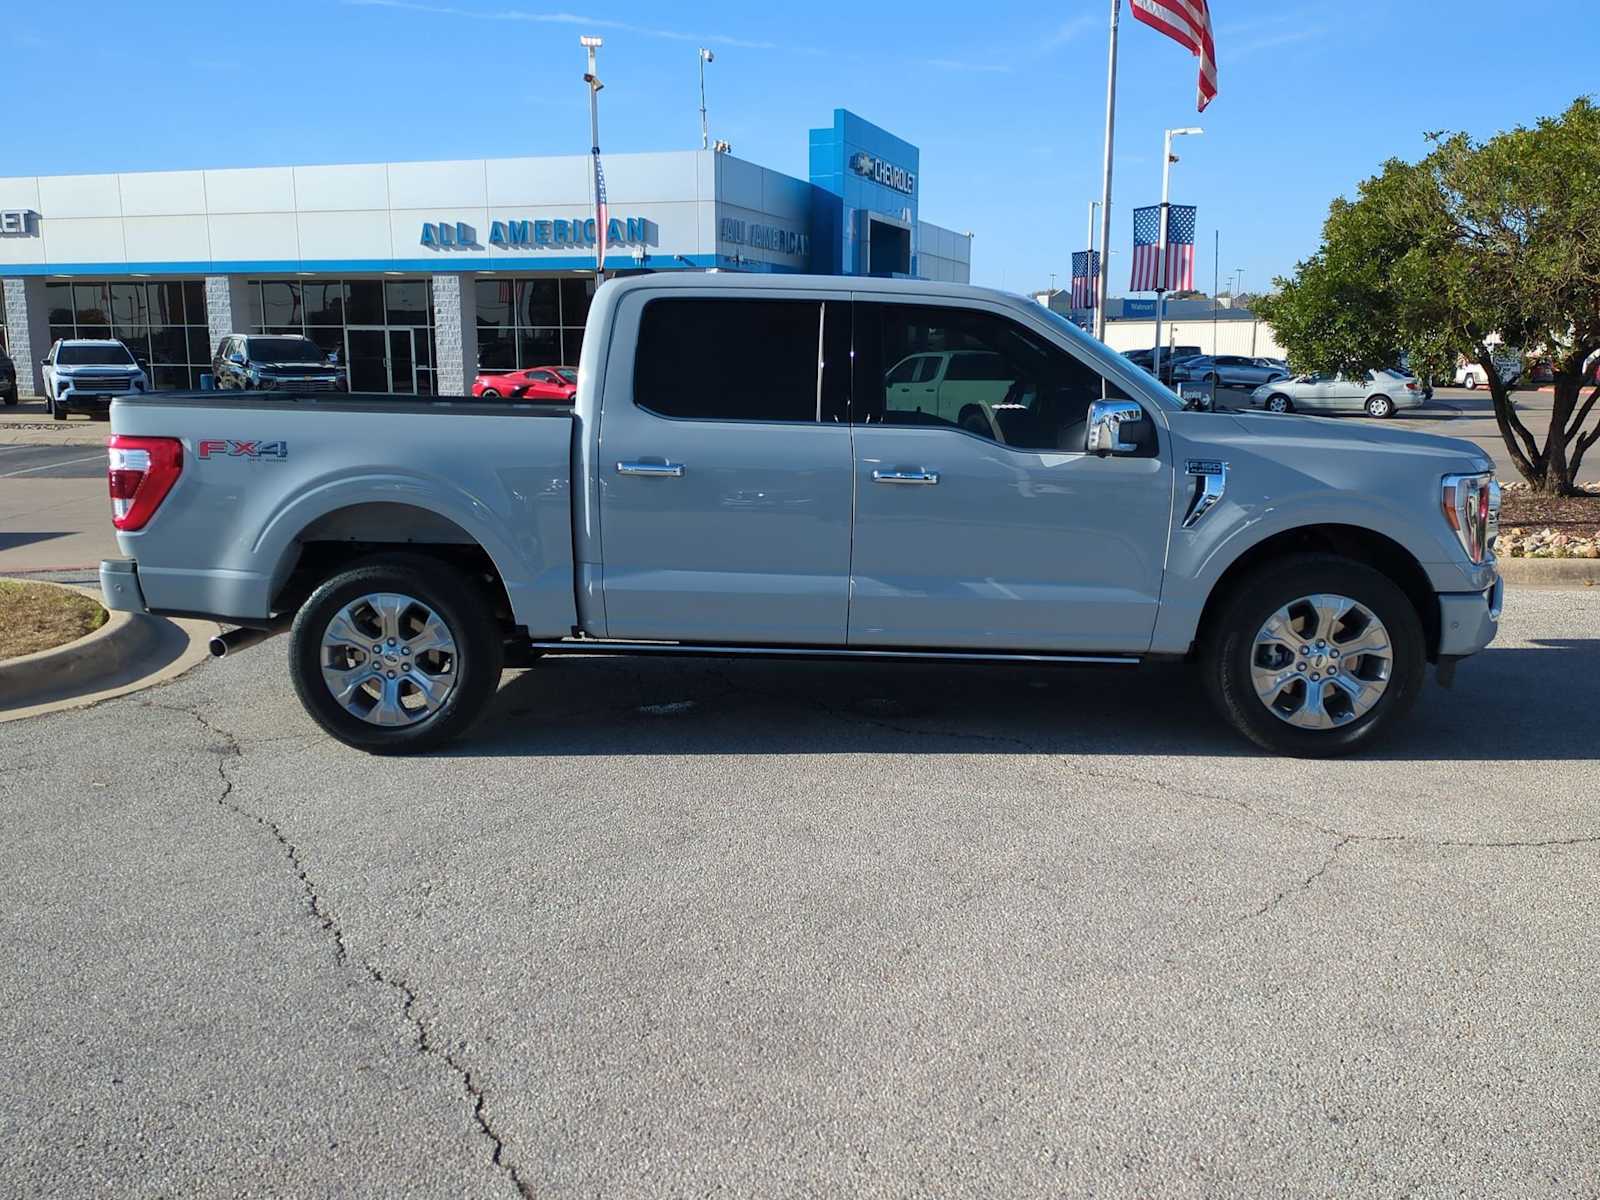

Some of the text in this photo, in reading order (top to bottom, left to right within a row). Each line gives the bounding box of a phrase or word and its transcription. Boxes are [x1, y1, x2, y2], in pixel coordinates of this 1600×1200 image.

[874, 158, 915, 195] CHEVROLET
[0, 209, 29, 232] ET
[420, 217, 646, 246] ALL AMERICAN
[1130, 302, 1154, 311] Walmart
[198, 439, 288, 460] FX4
